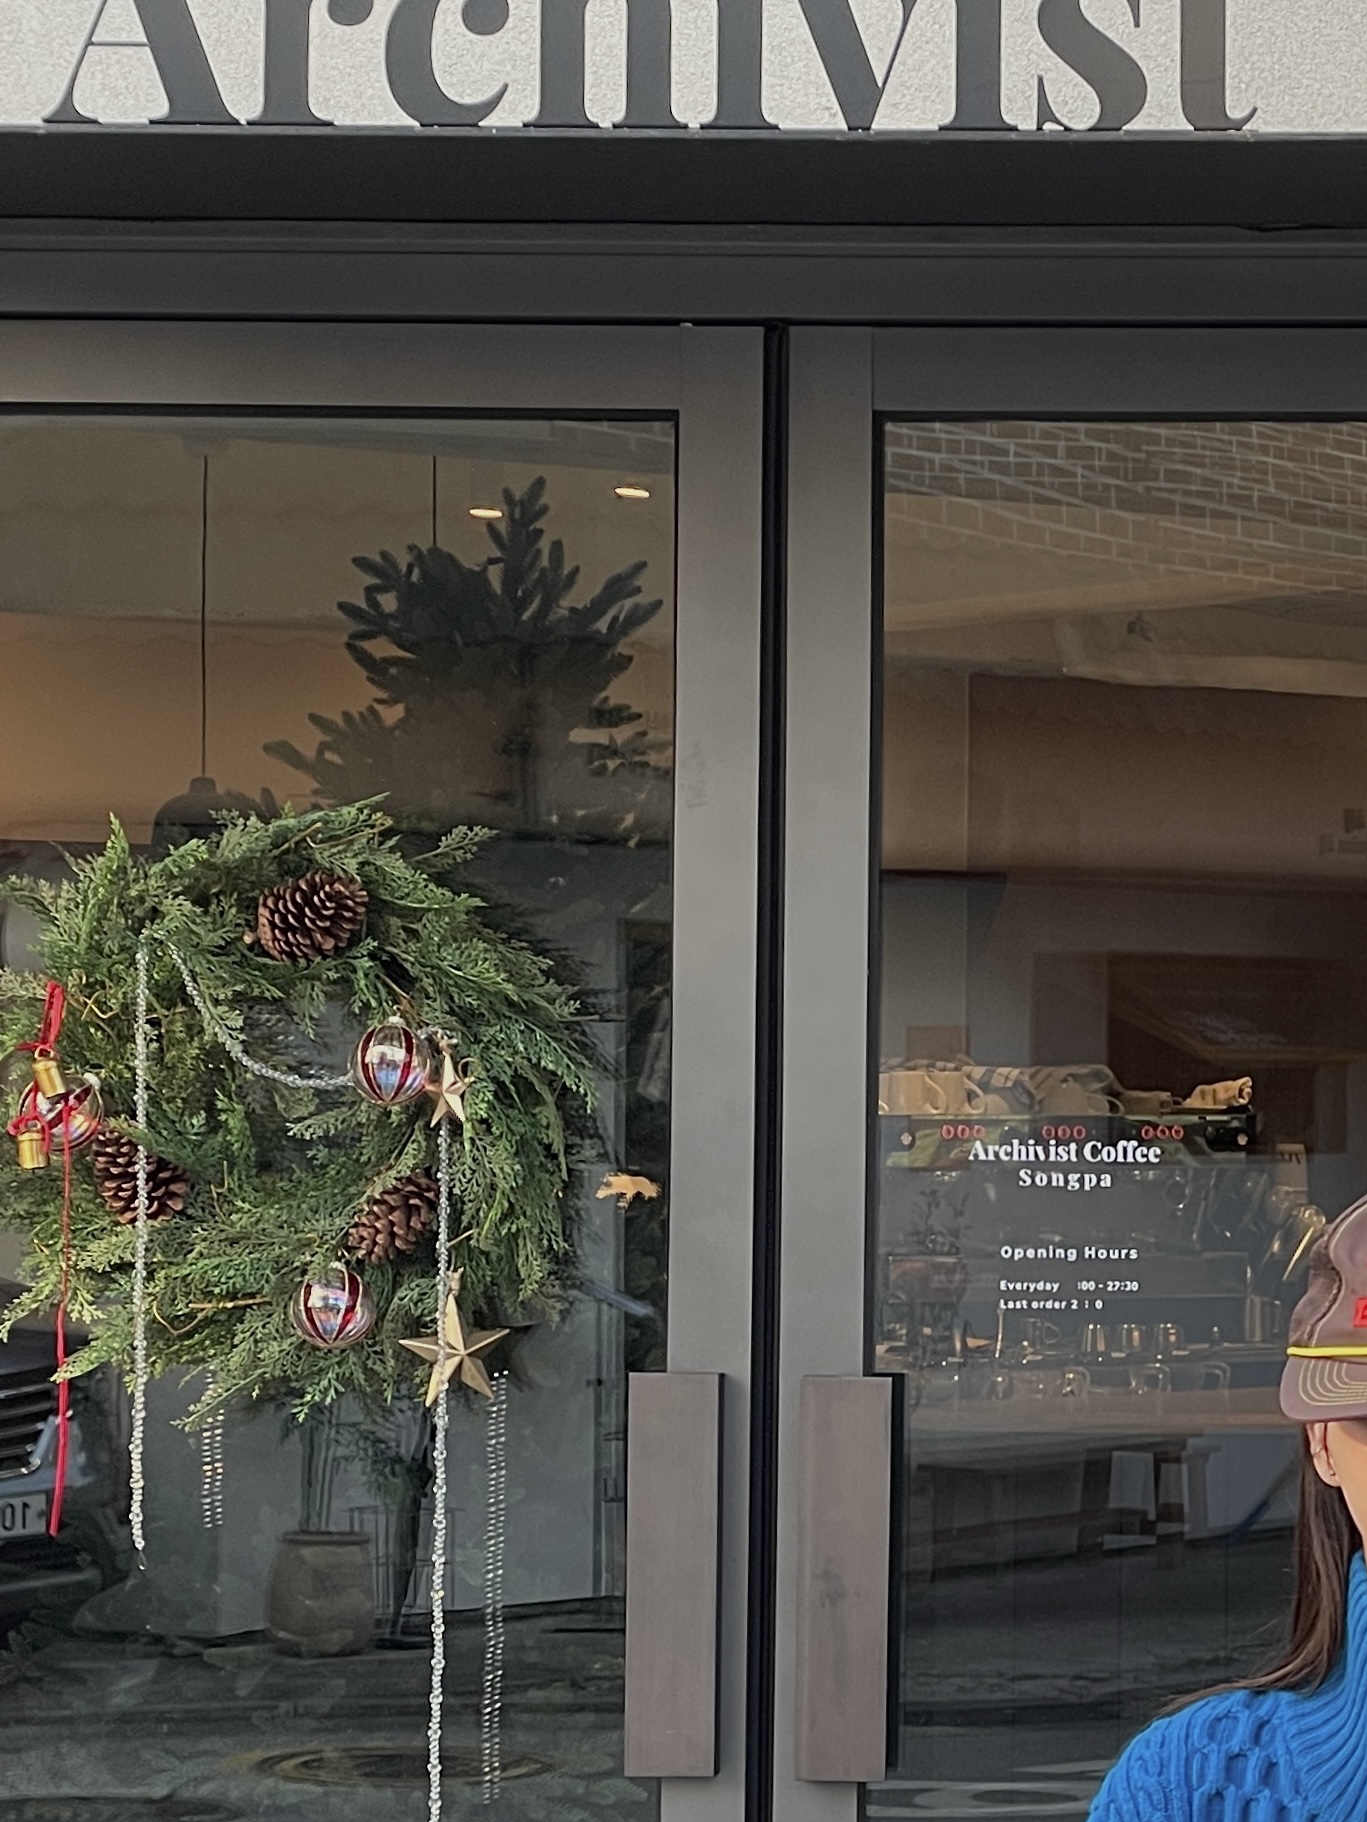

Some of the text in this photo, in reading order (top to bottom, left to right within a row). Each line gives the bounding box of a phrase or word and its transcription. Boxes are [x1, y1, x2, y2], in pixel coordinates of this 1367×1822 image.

[968, 1138, 1162, 1163] Archivist Coffee
[1018, 1168, 1112, 1191] Songpa
[1000, 1245, 1138, 1262] Opening Hours
[999, 1279, 1060, 1293] Everyday
[999, 1298, 1028, 1310] Last
[1030, 1299, 1067, 1310] order
